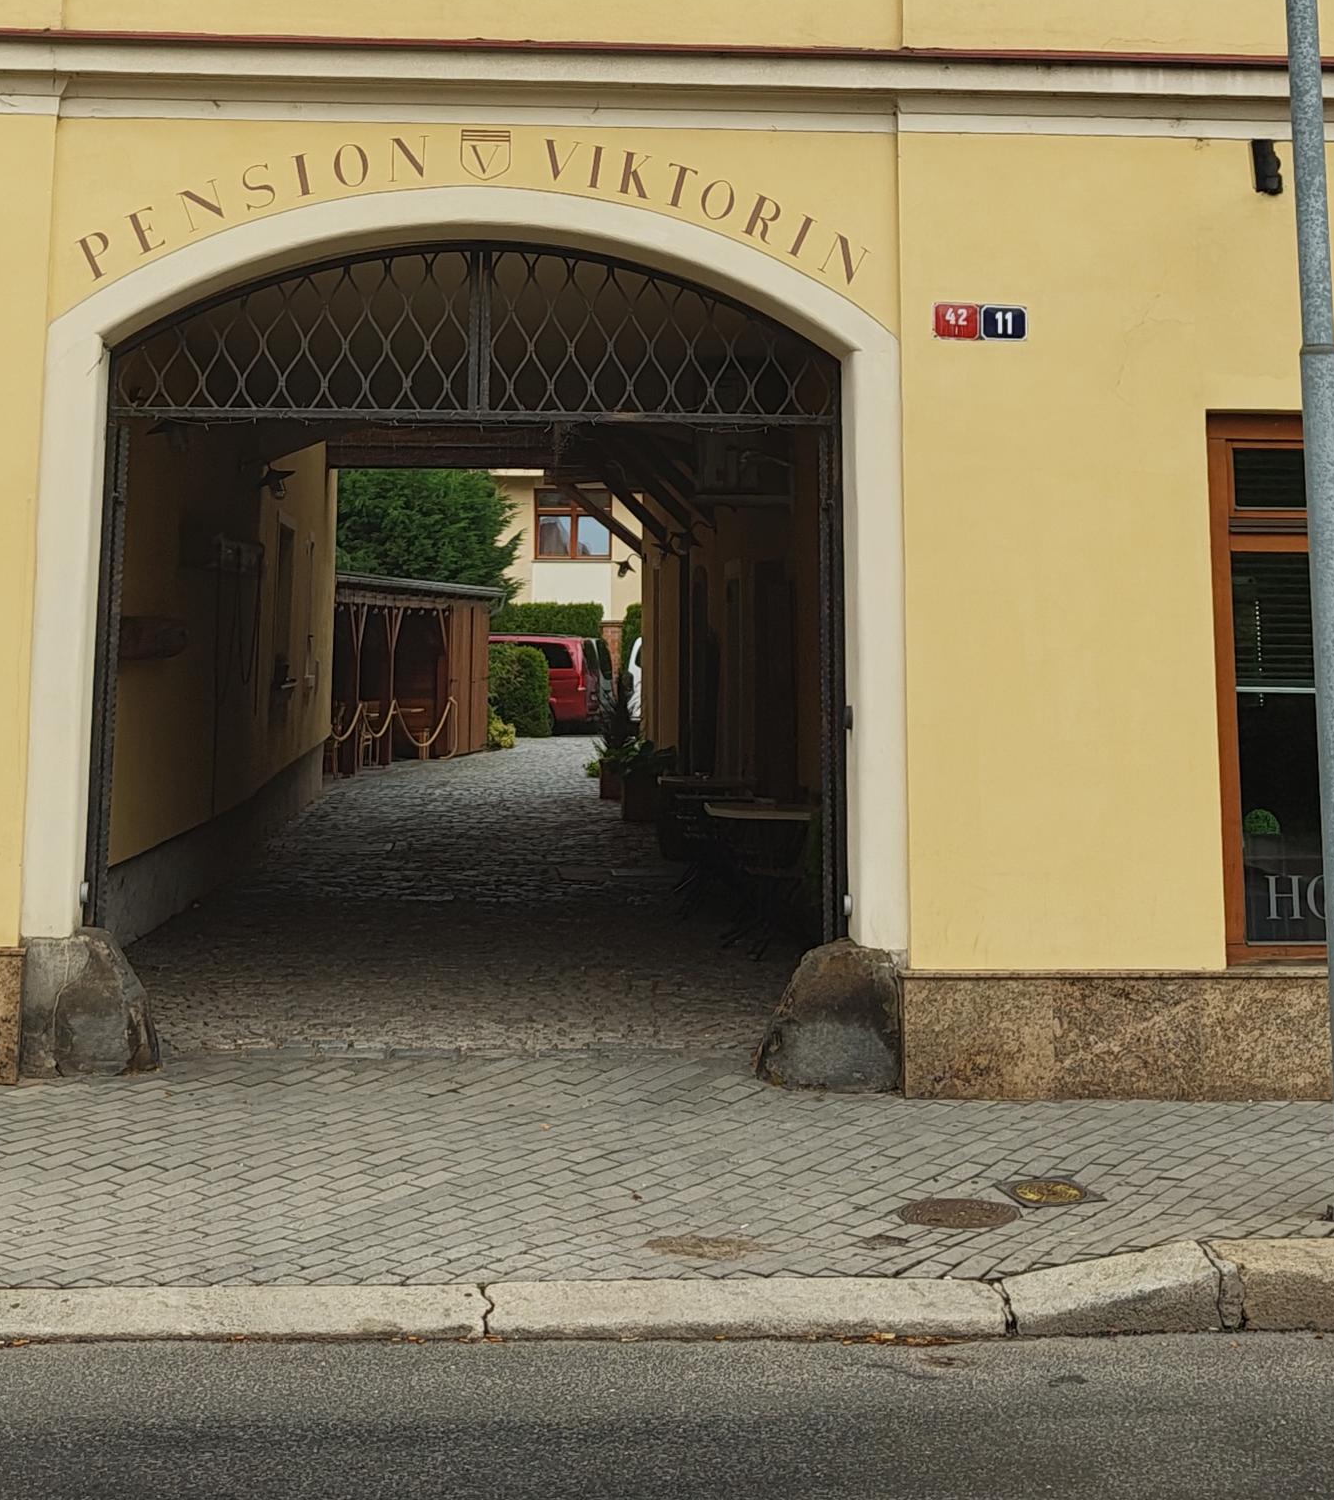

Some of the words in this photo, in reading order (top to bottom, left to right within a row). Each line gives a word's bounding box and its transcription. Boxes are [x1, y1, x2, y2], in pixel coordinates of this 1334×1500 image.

[469, 143, 504, 175] V
[74, 135, 430, 283] PENSION
[544, 138, 872, 287] VIKTORIN
[945, 307, 968, 326] 42
[995, 311, 1013, 335] 11
